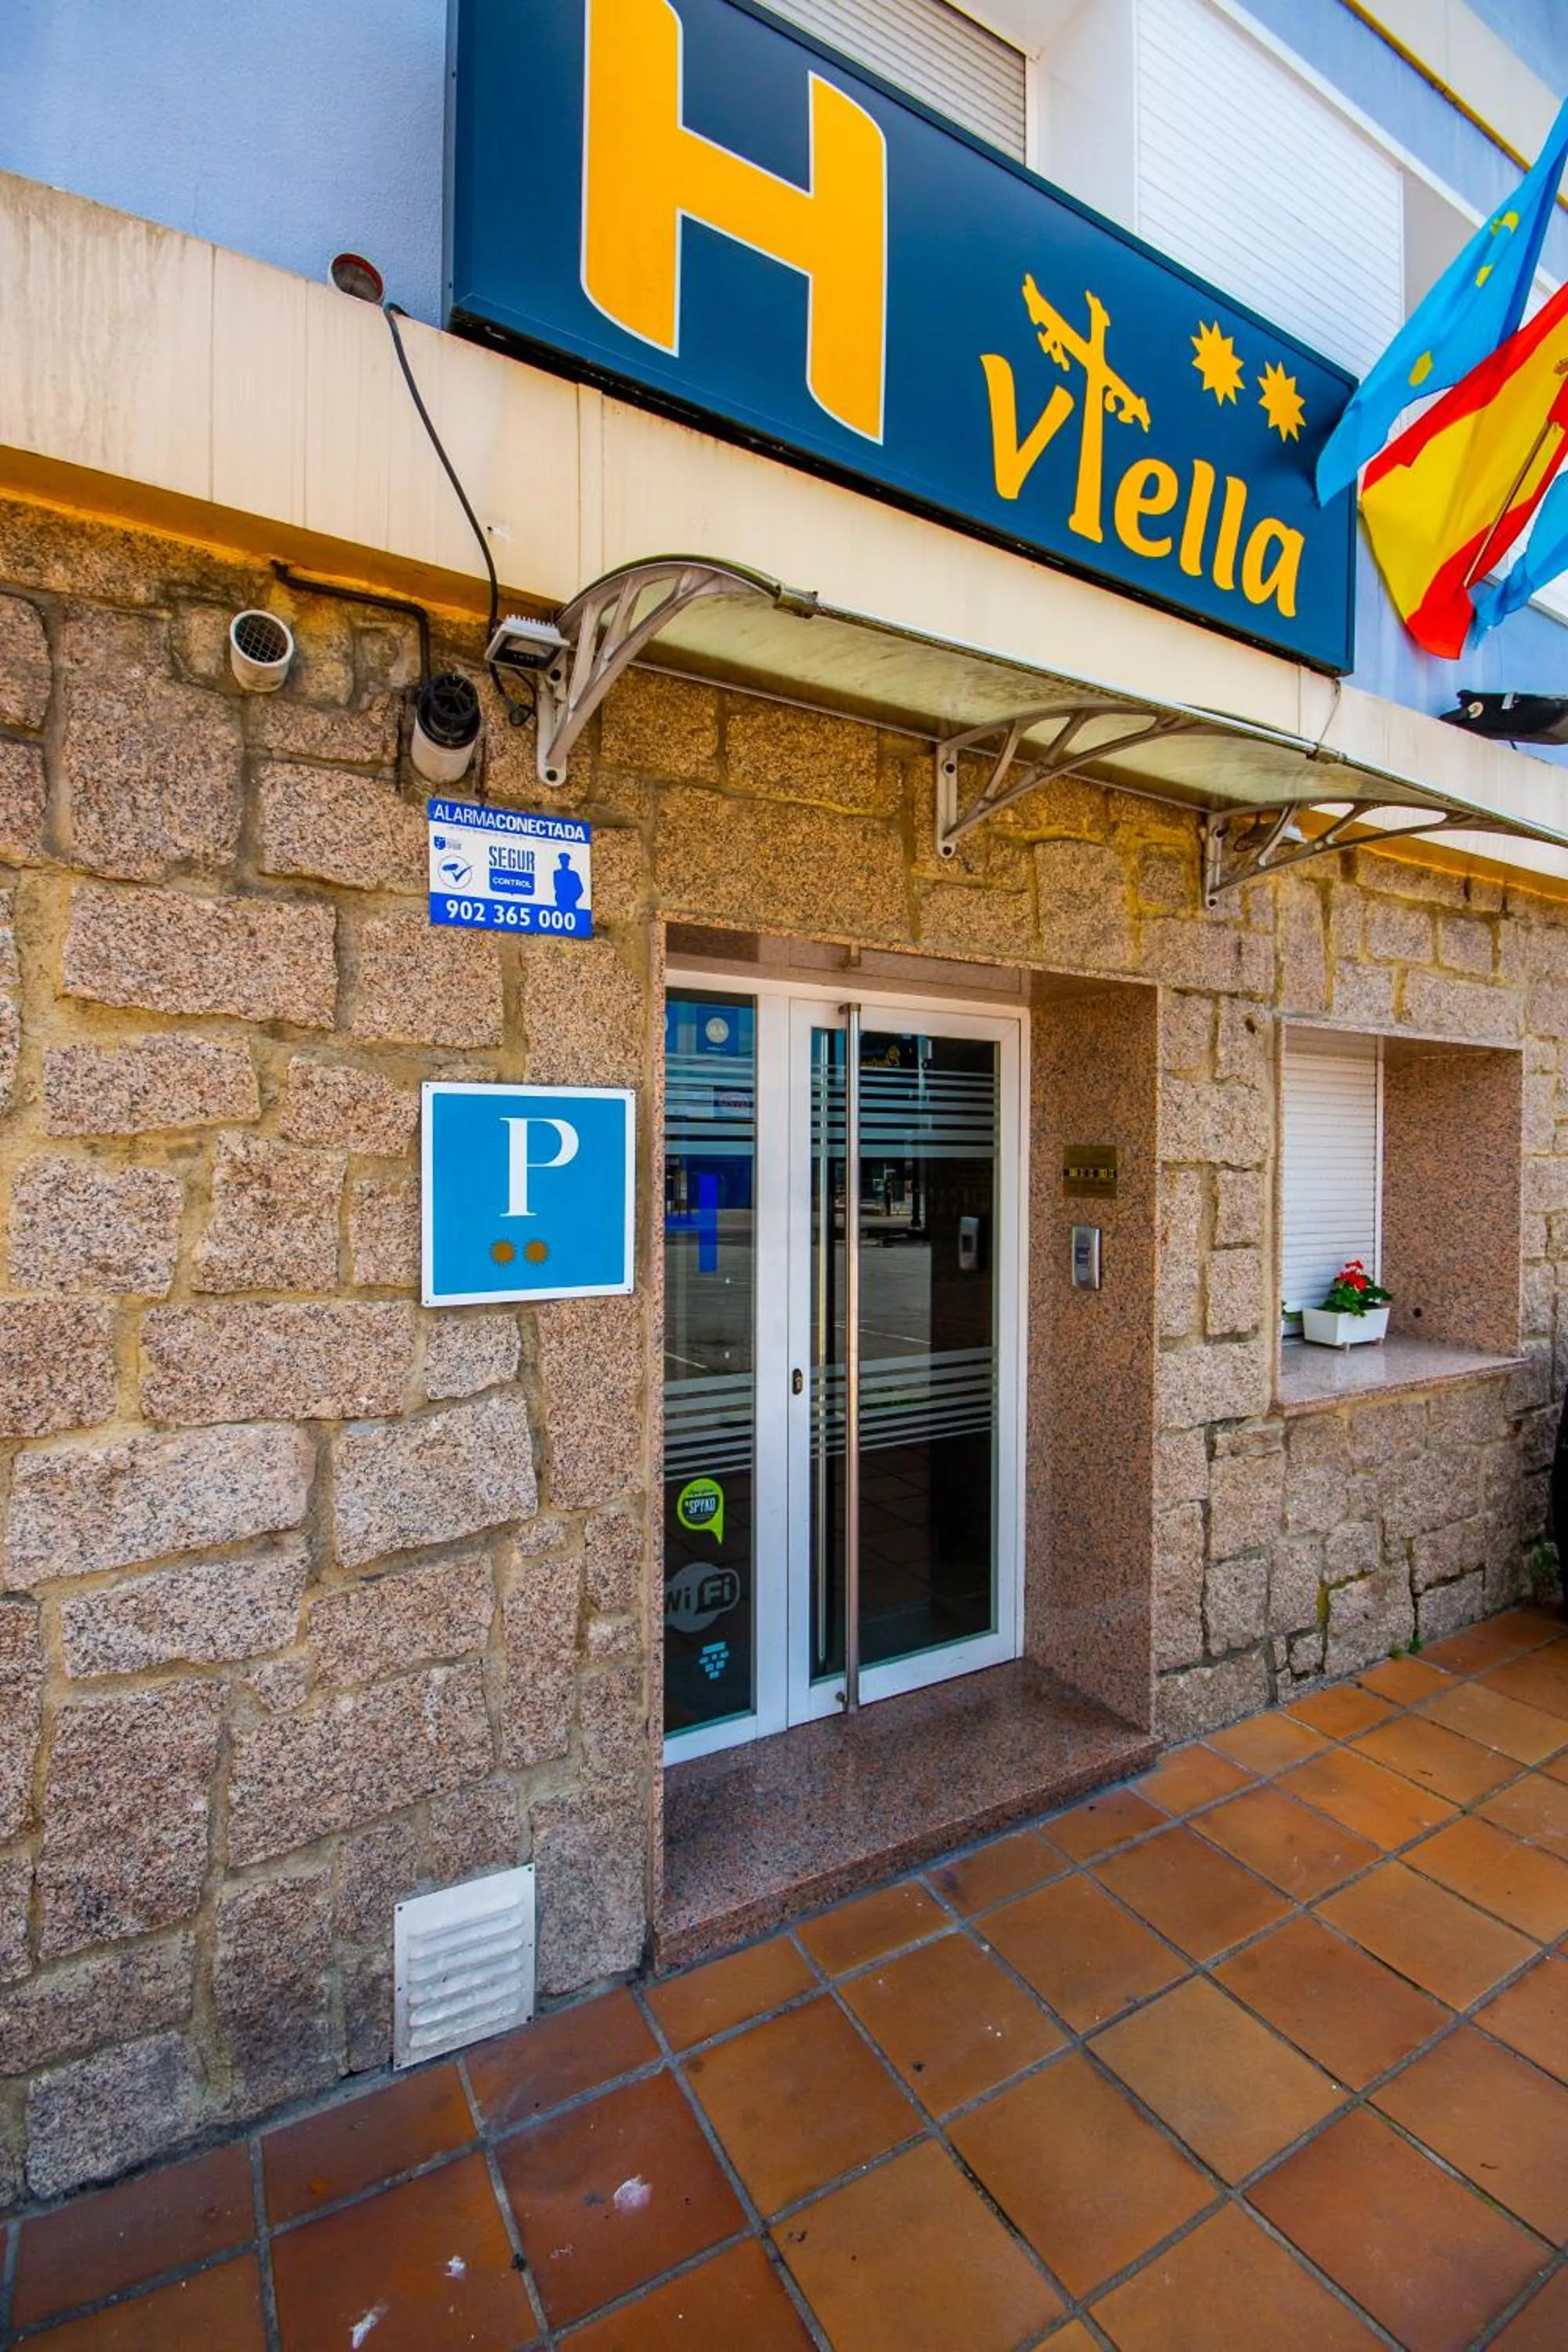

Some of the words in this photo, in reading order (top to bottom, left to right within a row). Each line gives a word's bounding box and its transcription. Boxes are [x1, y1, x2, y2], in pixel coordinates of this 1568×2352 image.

[580, 0, 887, 445] H
[980, 274, 1305, 618] Viella
[434, 804, 586, 841] ALARMACONECTADA
[488, 845, 535, 873] SEGUR
[492, 877, 532, 889] CONTROL
[445, 899, 485, 922] 902
[493, 904, 531, 926] 365
[538, 909, 576, 931] 000
[499, 1116, 579, 1218] P
